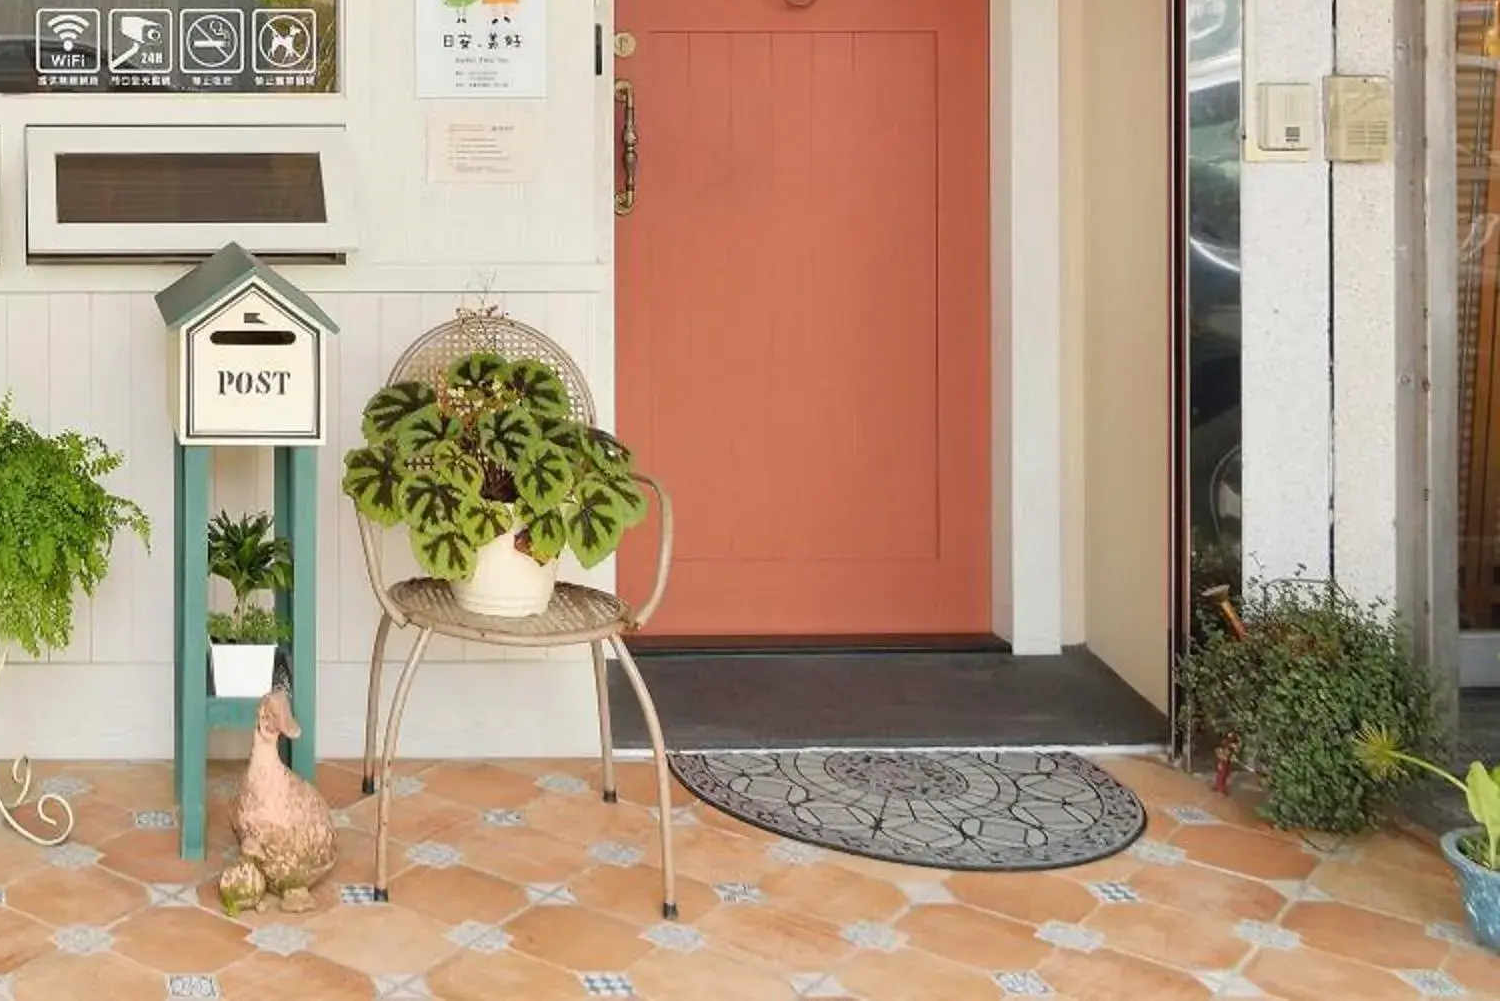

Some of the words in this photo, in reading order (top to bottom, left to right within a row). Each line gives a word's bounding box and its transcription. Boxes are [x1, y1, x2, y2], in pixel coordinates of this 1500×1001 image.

[51, 54, 85, 67] WiFi
[141, 52, 163, 64] 24H
[217, 370, 291, 395] POST
